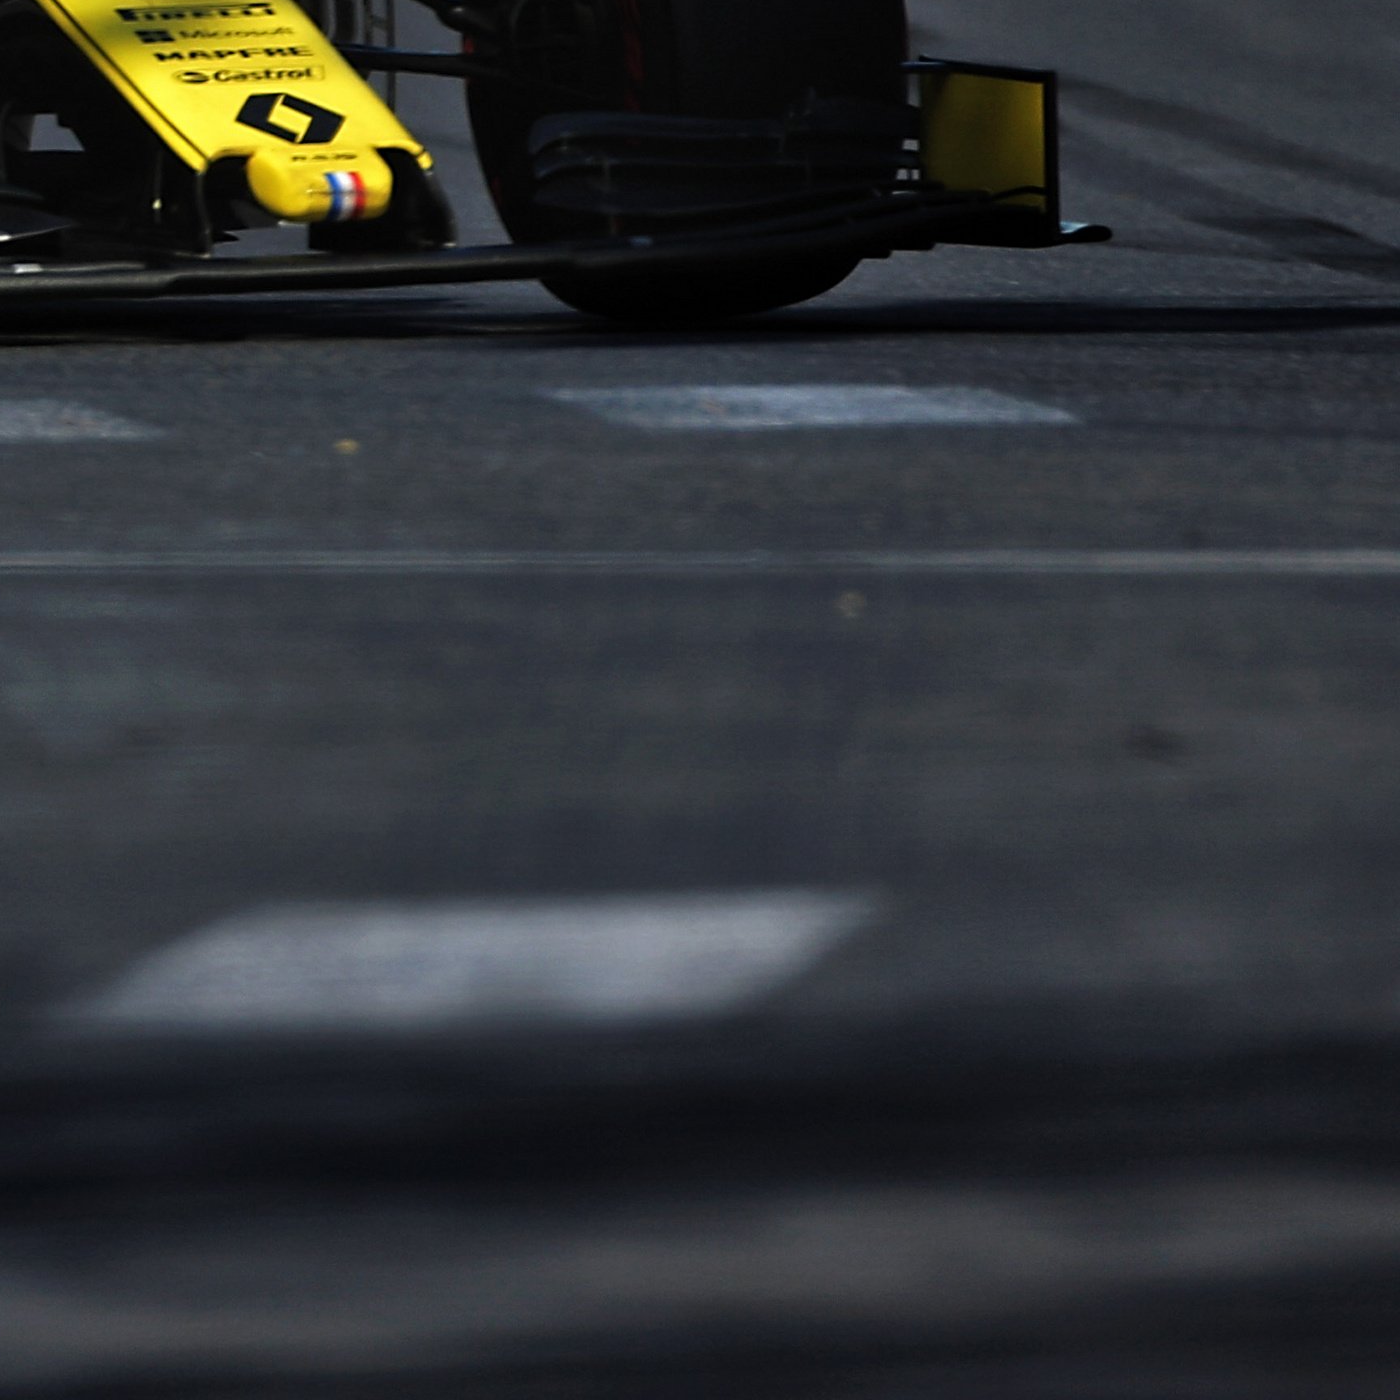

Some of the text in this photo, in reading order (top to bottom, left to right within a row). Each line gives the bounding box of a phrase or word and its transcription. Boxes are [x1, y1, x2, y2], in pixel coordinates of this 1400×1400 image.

[178, 26, 295, 40] Microsoft
[153, 45, 314, 62] MAPFRE
[213, 67, 313, 82] Castrol
